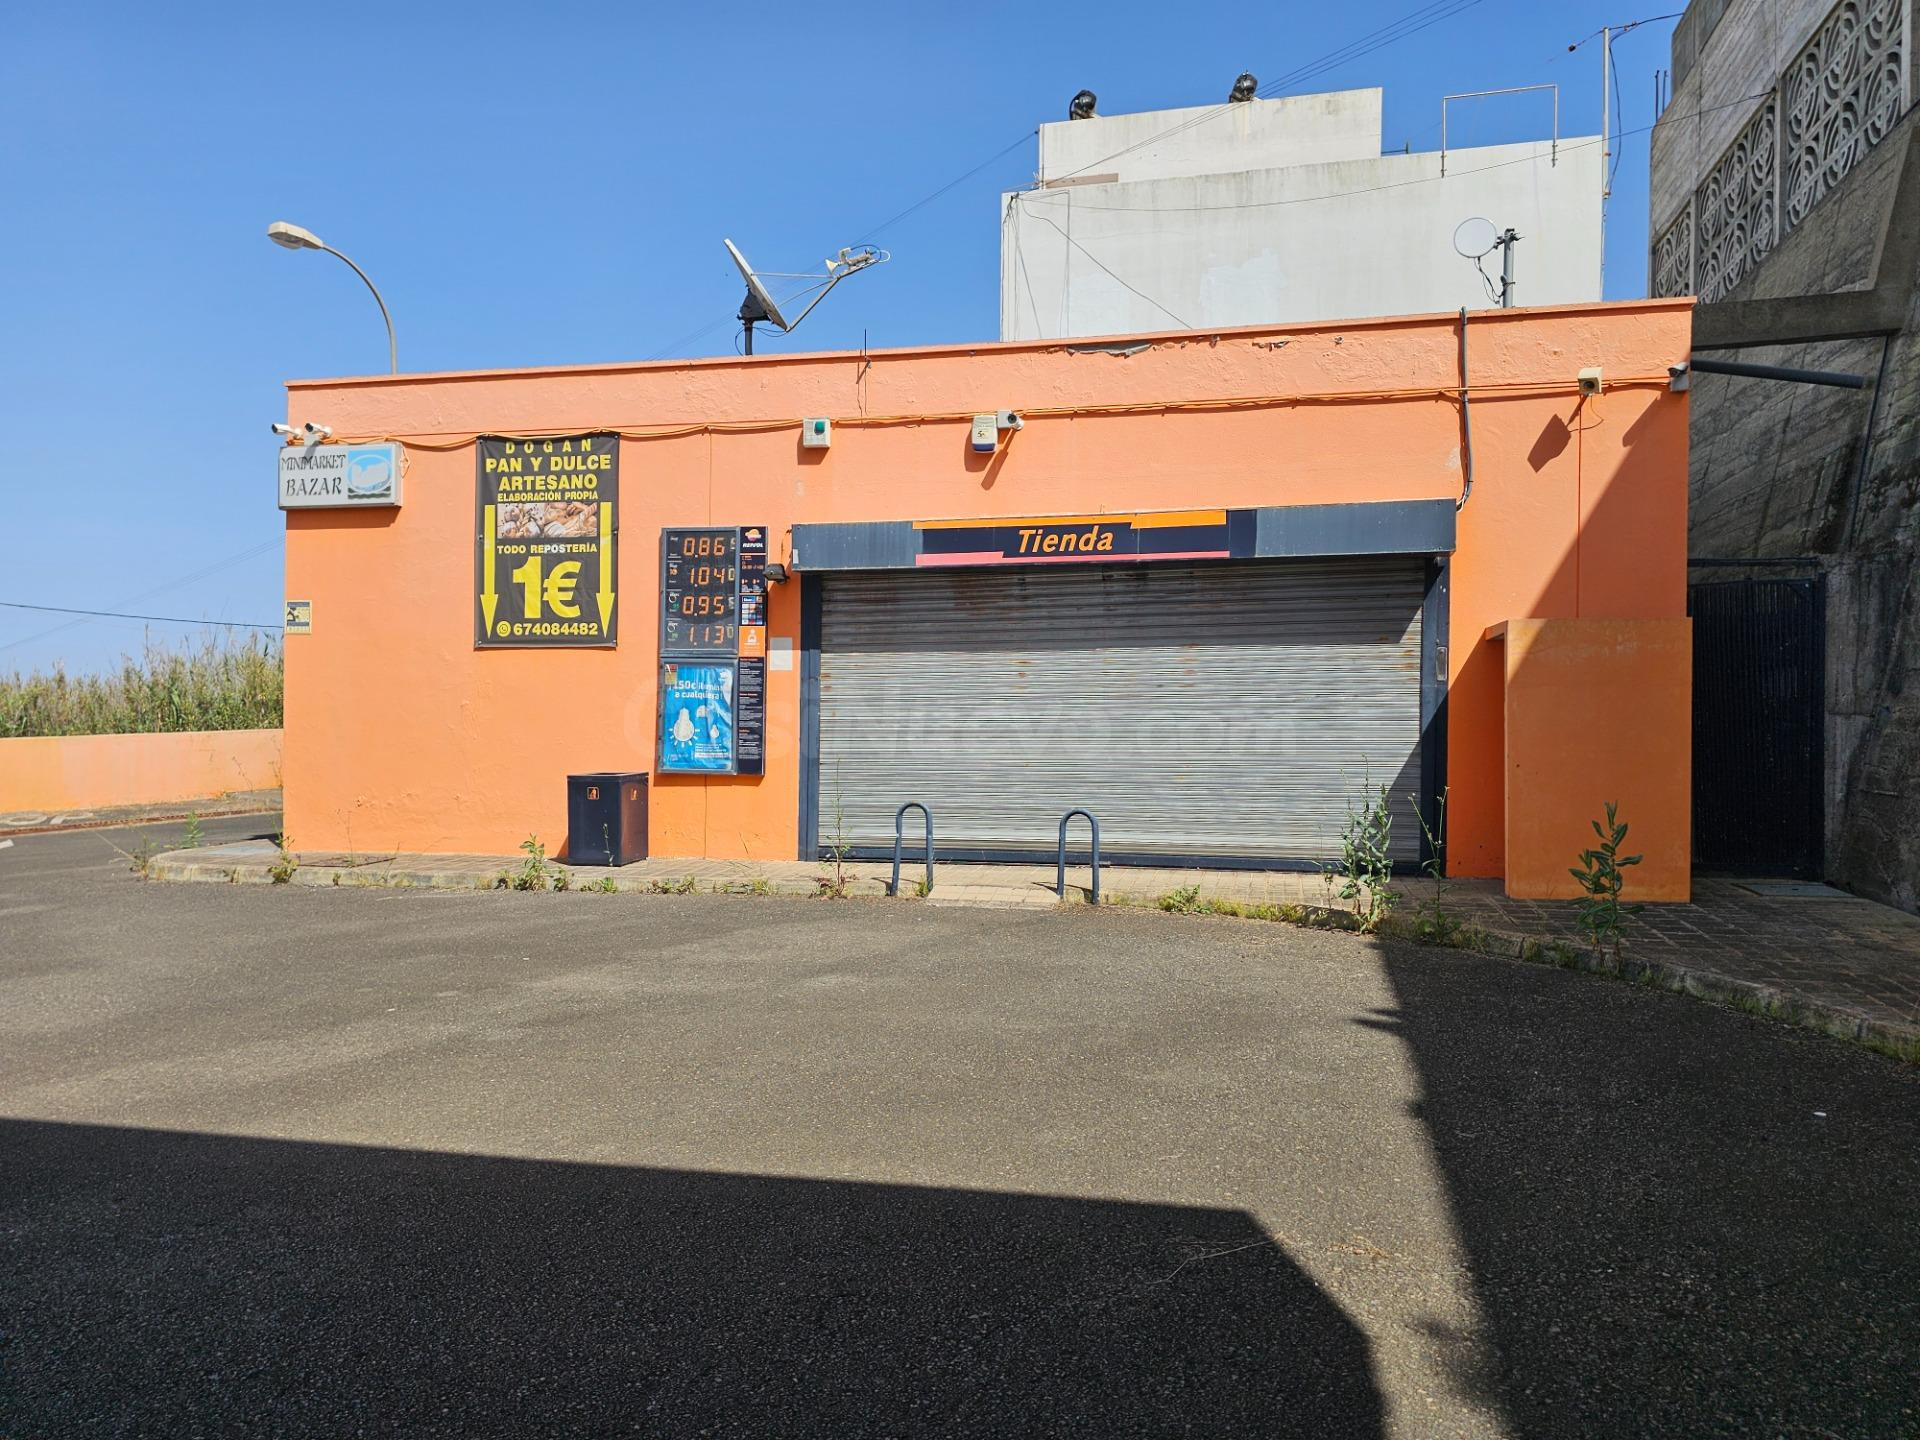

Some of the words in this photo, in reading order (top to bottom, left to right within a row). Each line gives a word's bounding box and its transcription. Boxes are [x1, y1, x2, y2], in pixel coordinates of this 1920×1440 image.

[505, 439, 592, 454] DOGAN
[281, 454, 346, 471] MINIMARKET
[485, 457, 522, 473] PAN
[530, 457, 543, 472] Y
[550, 454, 611, 471] DULCE
[285, 477, 342, 496] BAZAR
[498, 474, 598, 492] ARTESANO
[497, 490, 561, 502] ELABORACIÓN
[564, 489, 599, 501] PROPIA
[1015, 524, 1114, 554] Tienda
[497, 545, 527, 554] TODO
[512, 556, 581, 619] 1€
[513, 622, 598, 636] 674084482
